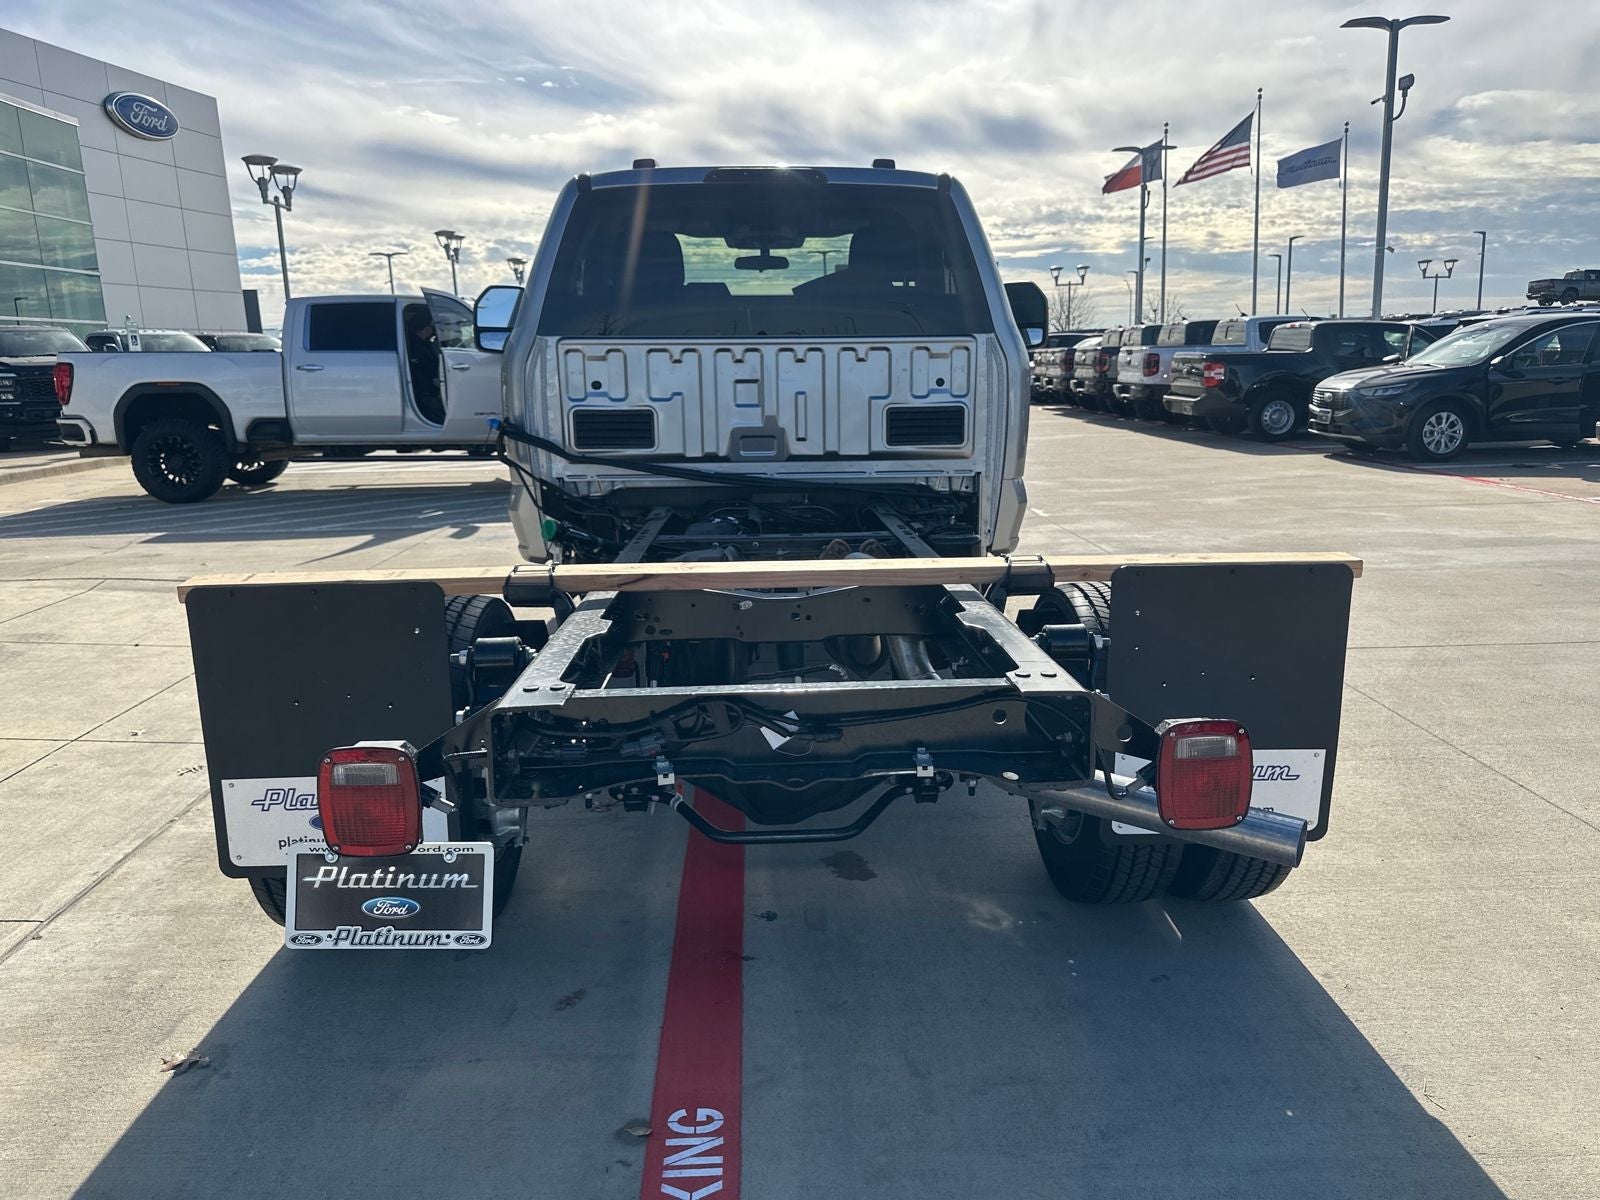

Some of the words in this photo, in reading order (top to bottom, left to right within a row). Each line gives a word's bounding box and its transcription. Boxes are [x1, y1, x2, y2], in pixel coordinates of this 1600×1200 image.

[130, 101, 168, 131] Ford
[302, 866, 479, 889] Platinum
[373, 899, 409, 916] Ford
[332, 927, 451, 946] Platinum
